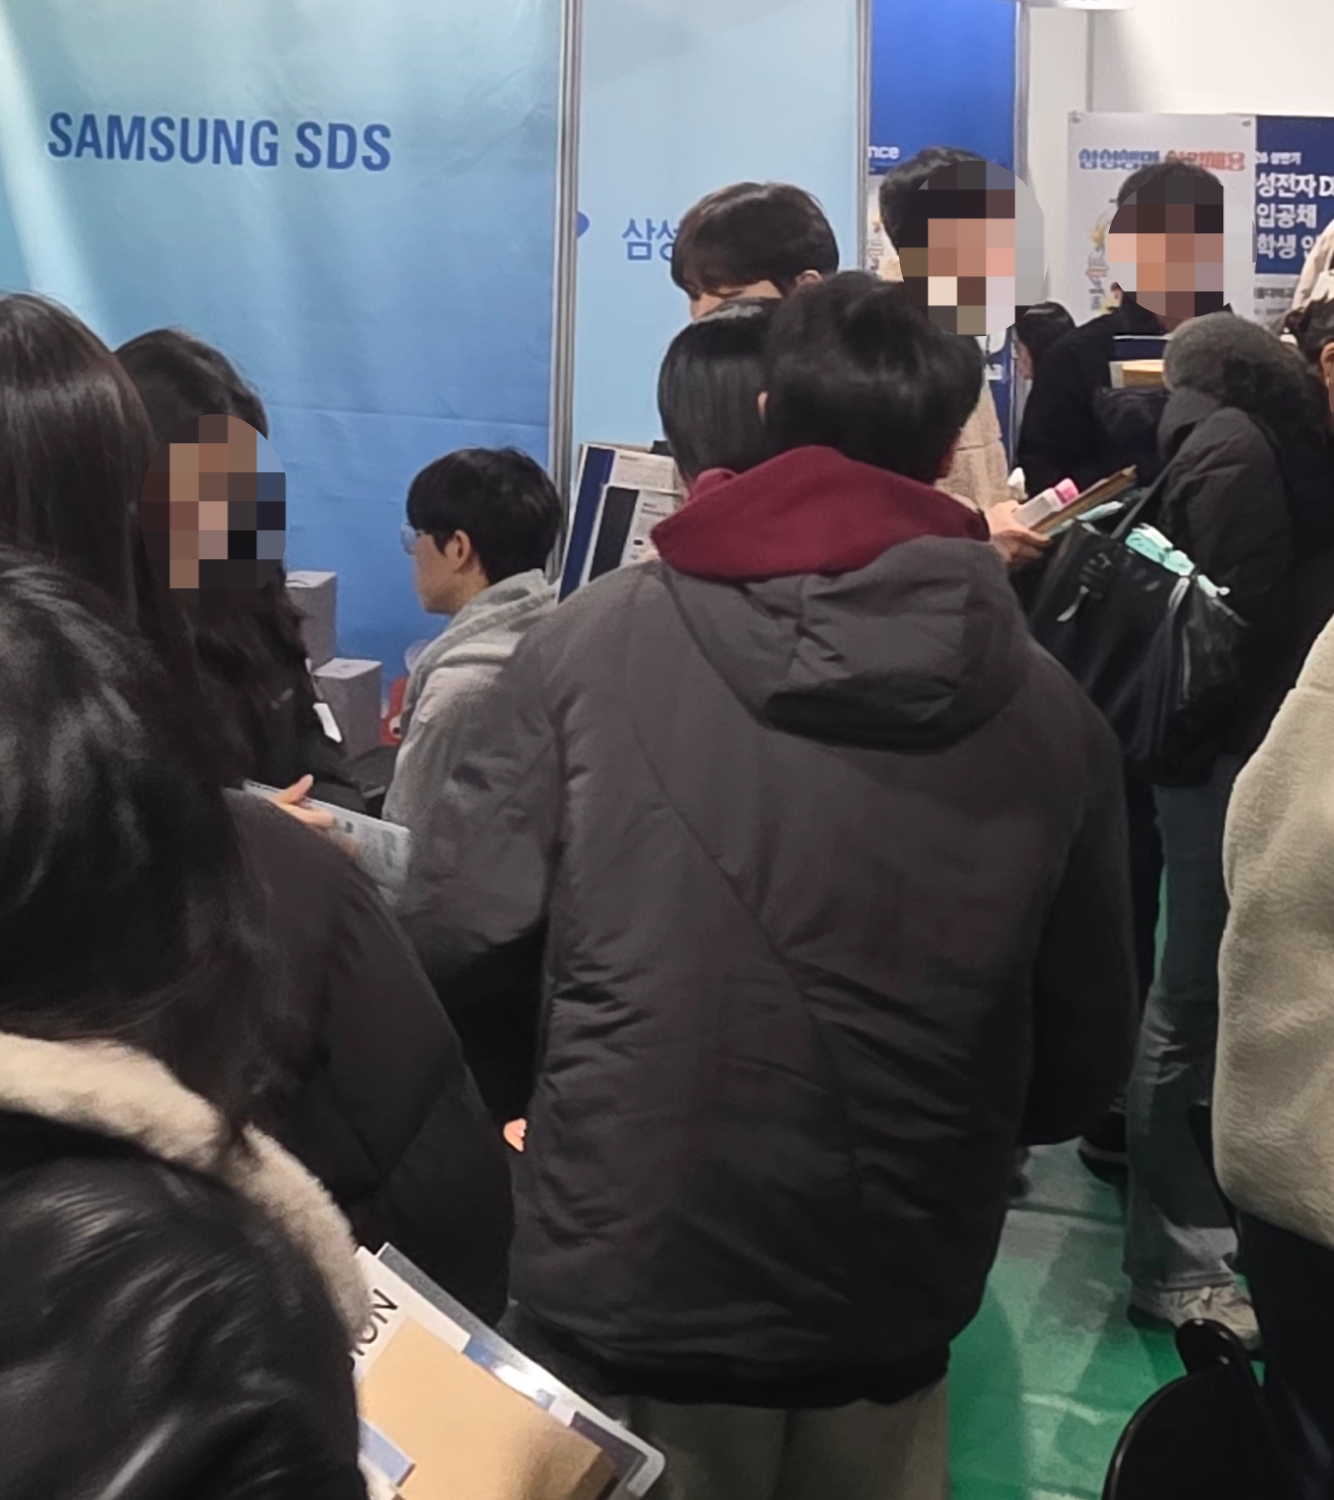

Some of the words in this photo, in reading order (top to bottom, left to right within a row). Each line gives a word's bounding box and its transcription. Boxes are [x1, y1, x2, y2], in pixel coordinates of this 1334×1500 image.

[48, 112, 278, 167] SAMSUNG
[295, 122, 392, 171] SDS
[868, 146, 899, 159] nce
[1257, 172, 1317, 198] 성전자
[1256, 203, 1317, 228] 입공채
[1257, 233, 1296, 259] 학생
